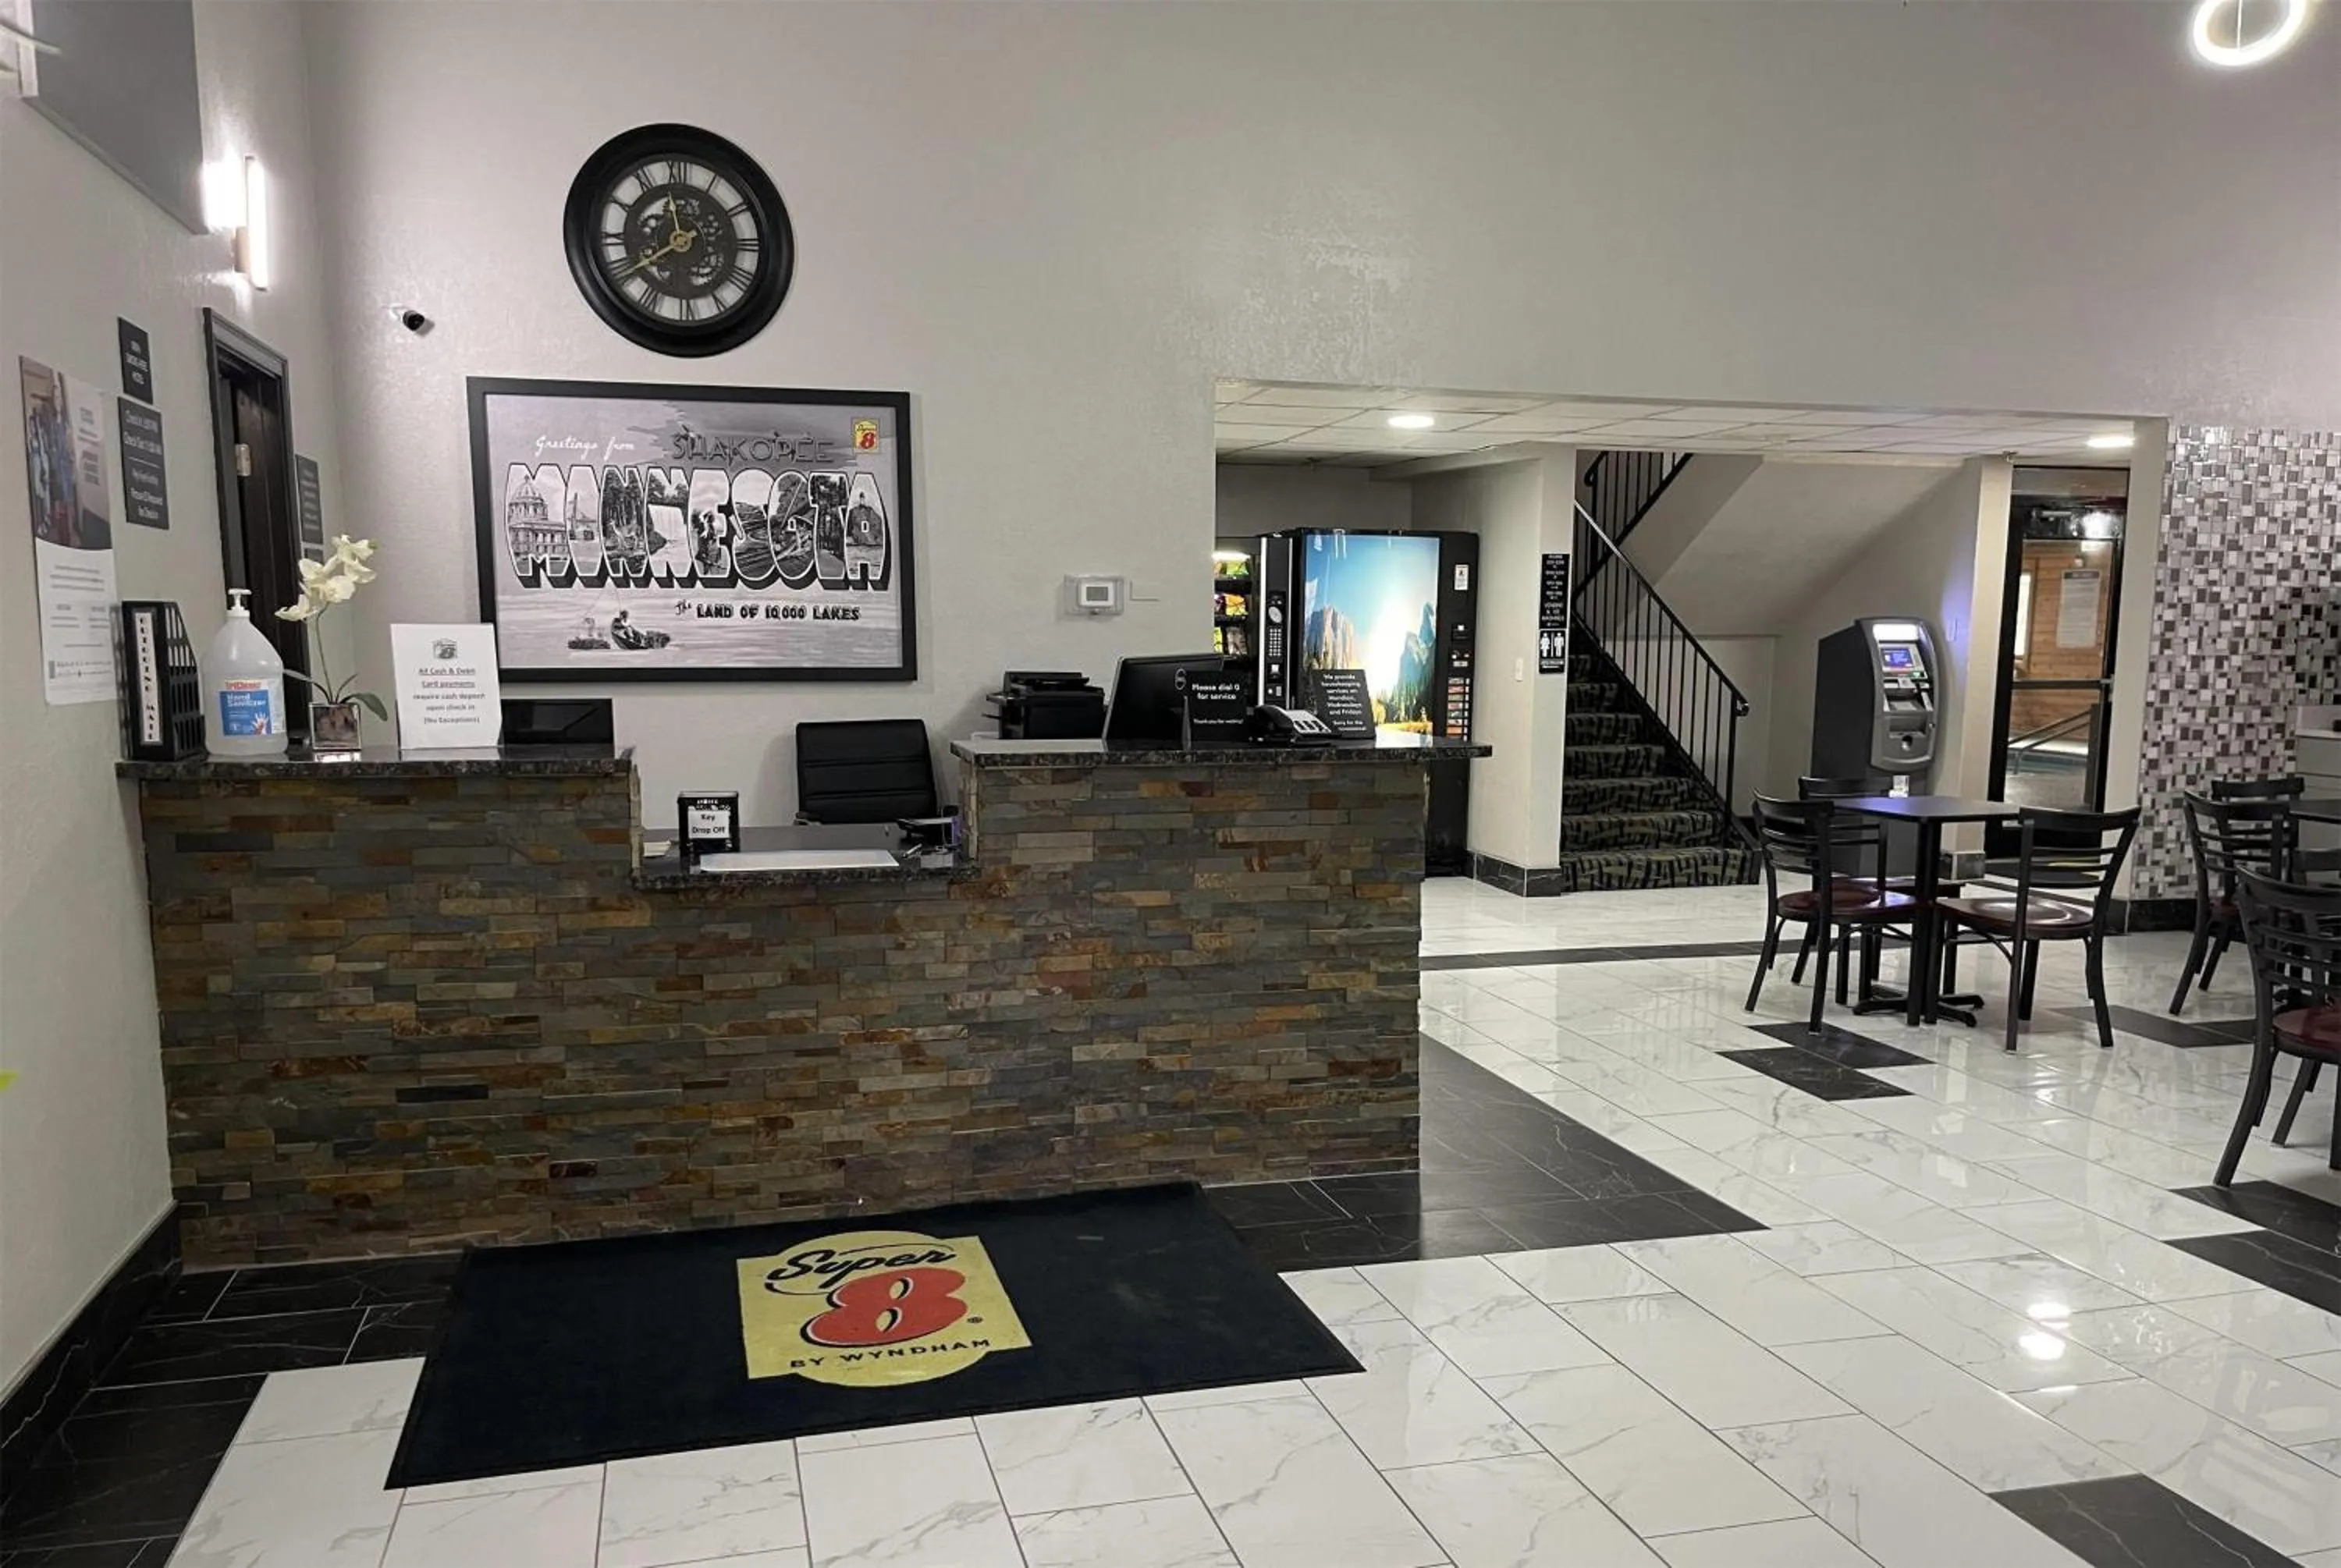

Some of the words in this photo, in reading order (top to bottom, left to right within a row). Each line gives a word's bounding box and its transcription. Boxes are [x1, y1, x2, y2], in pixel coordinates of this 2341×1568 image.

[535, 435, 599, 459] Greetings
[603, 435, 636, 460] from
[671, 431, 837, 463] SHAKOPEE
[506, 463, 891, 591] MINNESOTA
[697, 603, 733, 619] LAND
[741, 605, 759, 619] OF
[812, 605, 861, 621] LAKES
[766, 1247, 957, 1290] Super
[800, 1268, 968, 1348] 8
[790, 1356, 826, 1368] BY
[840, 1339, 991, 1362] WYNDHAM
